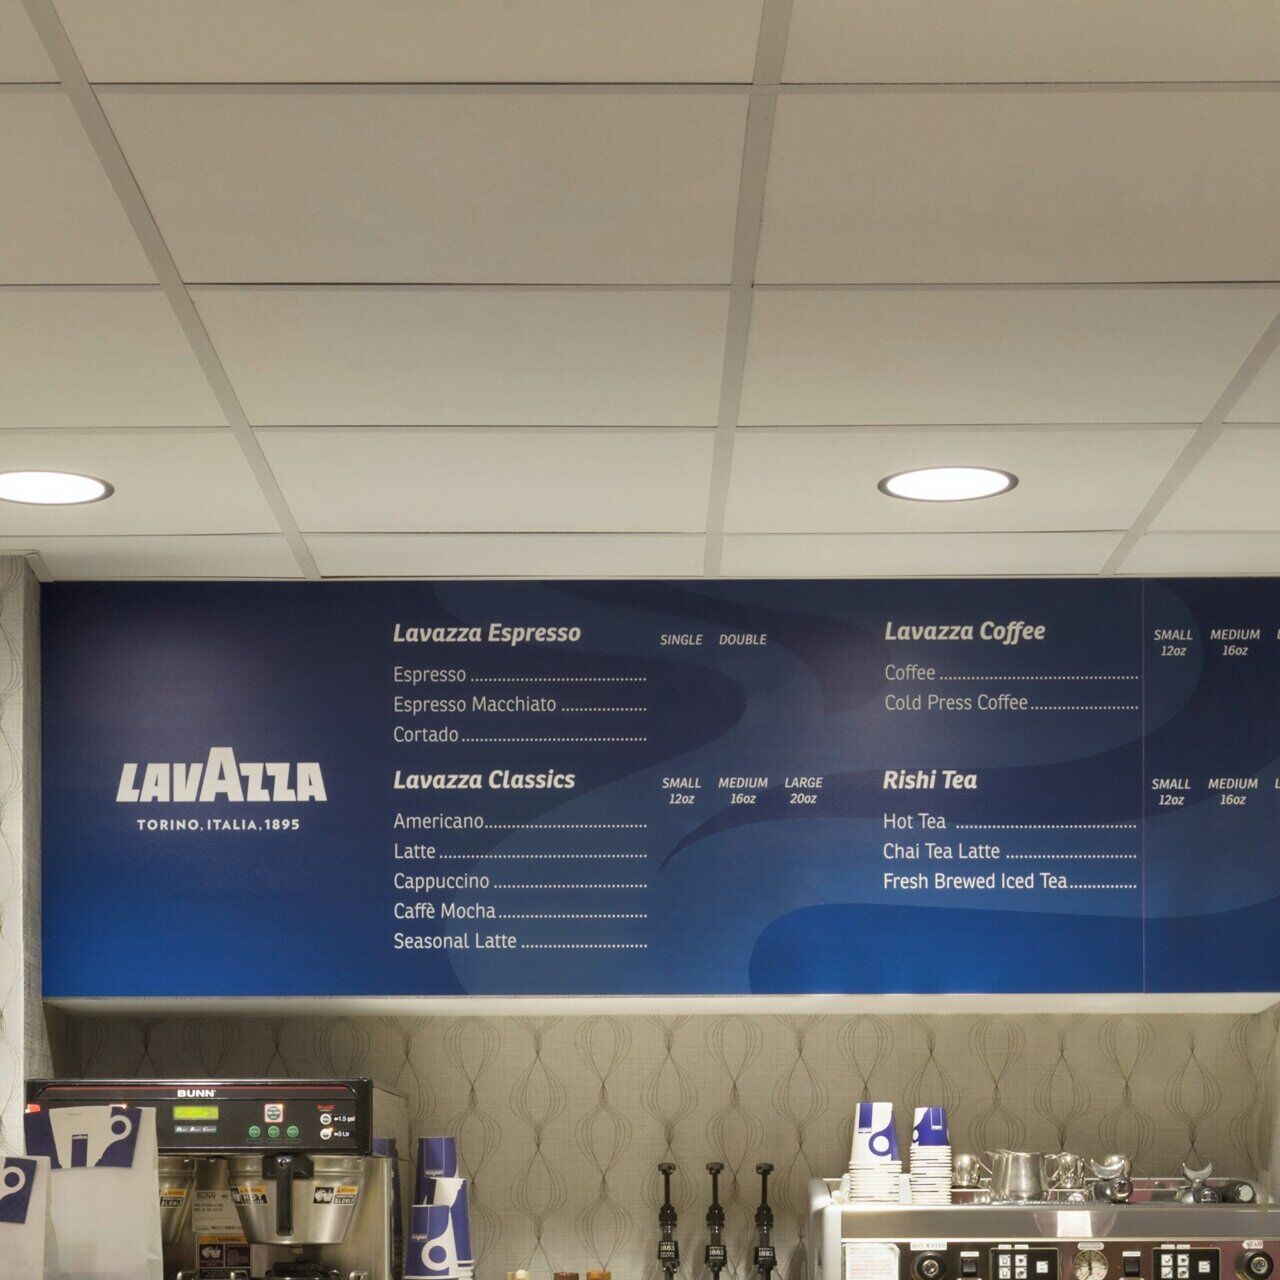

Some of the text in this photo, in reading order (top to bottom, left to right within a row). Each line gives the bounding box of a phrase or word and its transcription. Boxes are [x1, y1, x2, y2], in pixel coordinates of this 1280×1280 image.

[394, 623, 581, 646] Lavazza Espresso
[660, 634, 768, 645] SINGLE DOUBLE
[885, 621, 1045, 645] Lavazza Coffee
[1153, 629, 1193, 640] SMALL
[1210, 629, 1261, 640] MEDIUM
[1160, 645, 1187, 656] 12oz
[1222, 645, 1249, 656] 16oz
[394, 666, 467, 685] Espresso
[884, 664, 936, 681] Coffee
[394, 696, 557, 715] Espresso Macchiato
[885, 693, 1028, 711] Cold Press Coffee
[394, 726, 459, 743] Cortado
[116, 747, 328, 802] LAVAZZA
[394, 769, 576, 789] Lavazza Classics
[662, 777, 824, 789] SMALL MEDIUM LARGE
[883, 769, 978, 790] Rishi Tea
[1151, 779, 1191, 790] SMALL
[1208, 778, 1259, 789] MEDIUM
[668, 793, 817, 805] 12oz 16oz 20oz
[1158, 795, 1185, 806] 12oz
[1220, 794, 1247, 805] 16oz
[265, 819, 300, 831] 1895
[394, 813, 484, 830] Americano
[883, 812, 947, 830] Hot Tea
[394, 844, 436, 860] Latte
[883, 842, 1001, 860] Chai Tea Latte
[394, 873, 490, 893] Cappuccino
[884, 872, 1069, 889] Fresh Brewed Iced Tea
[394, 902, 496, 920] Caffè Mocha
[394, 932, 517, 950] Seasonal Latte
[177, 1089, 215, 1098] BUNN
